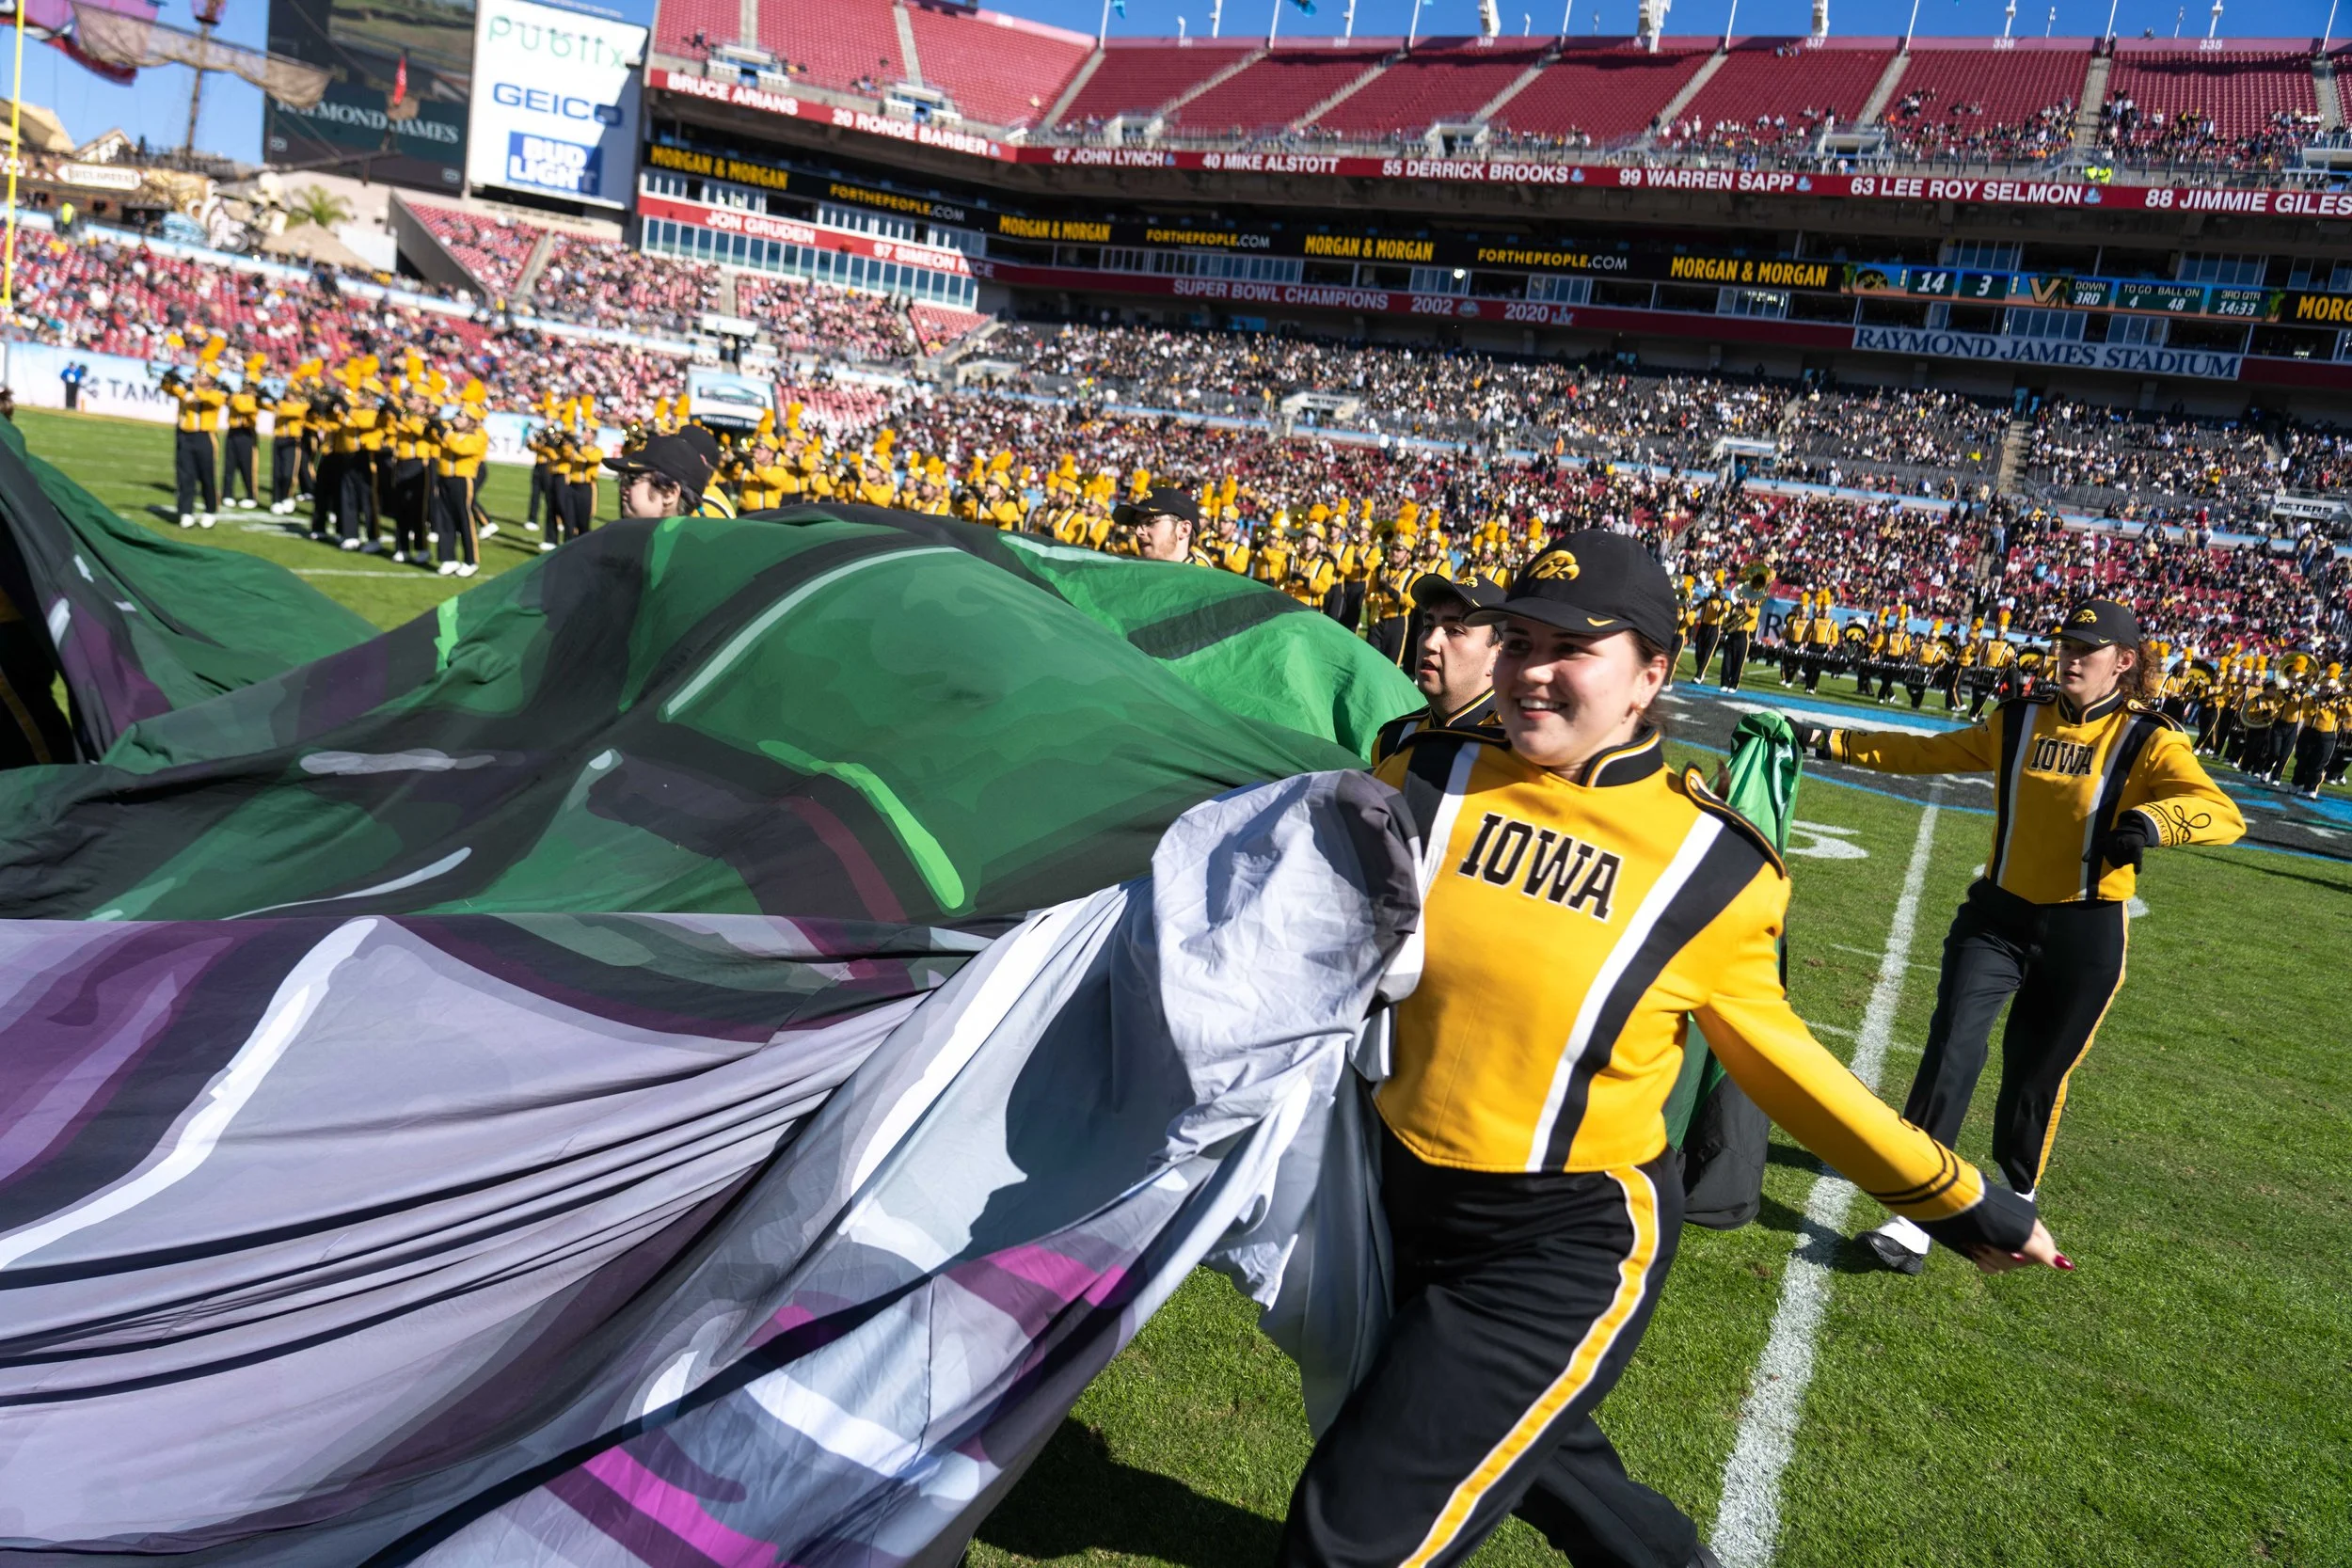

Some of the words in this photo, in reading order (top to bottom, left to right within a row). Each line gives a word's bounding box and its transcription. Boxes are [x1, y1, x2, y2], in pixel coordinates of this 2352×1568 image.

[494, 82, 623, 128] GEICO
[667, 72, 729, 102] BRUCE
[732, 87, 798, 115] ARIANS
[832, 108, 854, 127] 20
[918, 126, 989, 155] BARBER
[522, 135, 587, 169] BUD
[1052, 150, 1069, 164] 47
[1072, 150, 1112, 166] JOHN
[1114, 151, 1164, 167] LYNCH
[1202, 153, 1220, 168] 40
[1223, 153, 1263, 170] MIKE
[1264, 155, 1340, 174] ALSTOTT
[509, 154, 597, 193] LIGHT
[650, 145, 712, 175] MORGAN
[714, 157, 726, 178] &
[727, 161, 788, 190] MORGAN
[1382, 160, 1402, 177] 55
[1406, 161, 1485, 180] DERRICK
[1489, 164, 1568, 183] BROOKS
[1619, 169, 1643, 186] 99
[1646, 169, 1733, 190] WARREN
[1739, 172, 1794, 192] SAPP
[1851, 177, 1875, 196] 63
[1881, 178, 1923, 198] LEE
[1929, 181, 1978, 200] ROY
[1982, 182, 2082, 204] SELMON
[830, 183, 965, 221] FORTHEPEOPLE.COM
[2145, 188, 2174, 208] 88
[2180, 189, 2268, 213] JIMMIE
[2275, 194, 2352, 215] GILES
[706, 210, 741, 231] JON
[745, 214, 815, 244] GRUDEN
[999, 214, 1050, 239] MORGAN
[1051, 219, 1060, 239] &
[1061, 220, 1111, 242] MORGAN
[1146, 229, 1270, 249] FORTHEPEOPLE.COM
[873, 244, 894, 259] 97
[895, 246, 957, 271] SIMEON
[1305, 234, 1360, 257] MORGAN
[1362, 238, 1373, 258] &
[1375, 239, 1434, 261] MORGAN
[1478, 247, 1628, 271] FORTHEPEOPLE.COM
[1671, 257, 1739, 281] MORGAN
[1741, 261, 1753, 282] &
[1757, 261, 1829, 287] MORGAN
[1917, 271, 1947, 293] 14
[1173, 279, 1227, 298] SUPER
[1232, 282, 1280, 302] BOWL
[1284, 286, 1389, 310] CHAMPIONS
[1976, 275, 1993, 296] 3
[2075, 281, 2106, 292] DOWN
[2123, 284, 2137, 294] TO
[2137, 285, 2152, 295] GO
[2158, 286, 2183, 296] BALL
[2185, 287, 2200, 298] ON
[2221, 290, 2241, 300] 3RD
[2242, 291, 2261, 301] QTR
[1410, 296, 1454, 315] 2002
[2074, 293, 2101, 307] 3RD
[2129, 295, 2138, 309] 4
[2168, 298, 2185, 311] 48
[2217, 301, 2257, 316] 14:33
[1504, 303, 1549, 323] 2020
[1855, 329, 1997, 358] RAYMOND
[2001, 340, 2097, 366] JAMES
[2103, 346, 2239, 378] STADIUM
[2030, 737, 2094, 776] IOWA
[1458, 811, 1625, 924] IOWA
